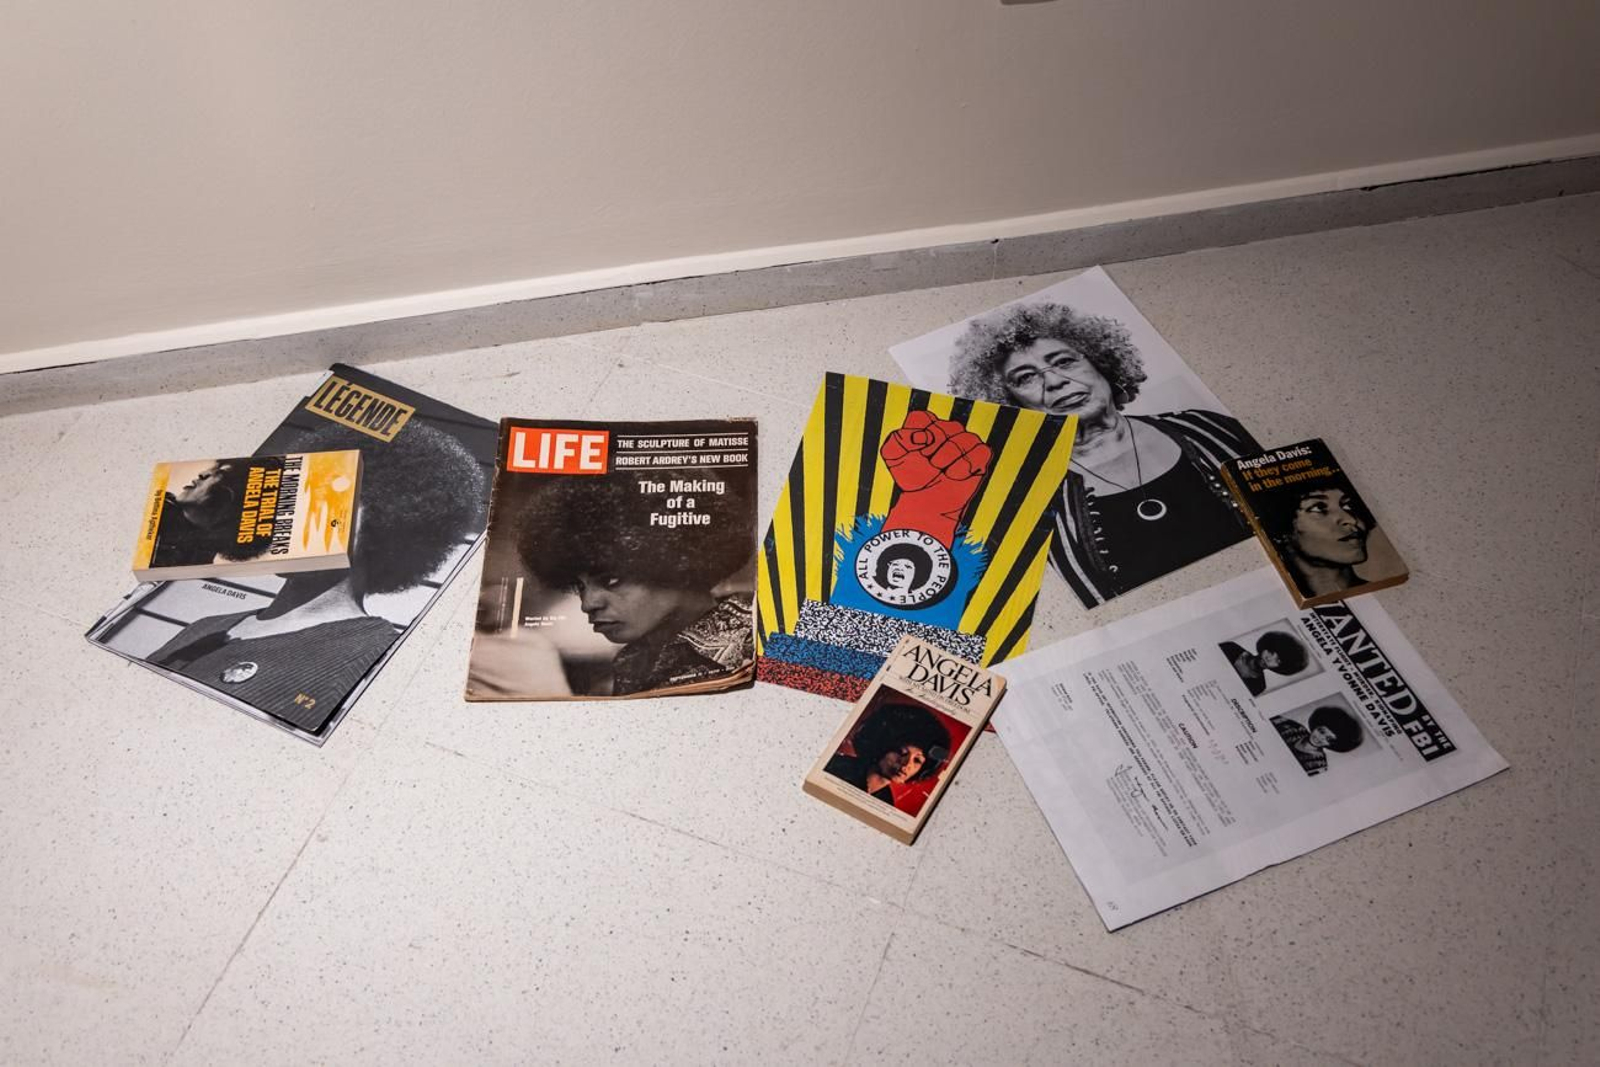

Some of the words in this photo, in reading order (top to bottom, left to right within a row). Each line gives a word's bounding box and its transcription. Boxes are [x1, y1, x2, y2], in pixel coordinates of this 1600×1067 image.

[313, 380, 408, 436] LÉGENDE
[512, 431, 605, 470] LIFE
[617, 438, 634, 449] THE
[637, 438, 690, 449] SCULPTURE
[693, 438, 706, 447] OF
[708, 436, 749, 447] MATISSE
[285, 456, 303, 472] THE
[615, 455, 651, 466] ROBERT
[652, 454, 697, 465] ARDREY'S
[699, 454, 721, 464] NEW
[723, 453, 749, 463] BOOK
[1236, 453, 1277, 471] Angela
[1276, 446, 1313, 461] Davis:
[1254, 465, 1280, 478] they
[1281, 459, 1313, 471] come
[243, 467, 265, 511] ANGELA
[263, 468, 282, 489] THE
[638, 480, 666, 494] The
[669, 479, 726, 495] Making
[1248, 481, 1262, 493] in
[1263, 477, 1283, 489] the
[258, 490, 278, 522] TRIAL
[277, 473, 300, 517] MORNING
[666, 495, 683, 509] of
[686, 498, 695, 509] a
[237, 511, 258, 544] DAVIS
[255, 523, 273, 539] OF
[650, 511, 711, 528] Fugitive
[271, 518, 294, 555] BREAKS
[864, 530, 910, 553] POWER
[917, 532, 934, 546] TO
[858, 558, 869, 580] ALL
[933, 546, 950, 569] THE
[202, 584, 227, 595] ANGELA
[900, 574, 947, 604] PEOPLE
[1309, 612, 1336, 647] INTERSTATE
[903, 644, 992, 698] ANGELA
[1301, 617, 1333, 656] ANGELA
[1332, 657, 1369, 701] YVONNE
[1365, 702, 1396, 737] DAVIS
[907, 663, 976, 706] DAVIS
[1178, 723, 1198, 749] CAUTION
[1403, 719, 1440, 756] FBI
[1421, 714, 1435, 728] BY
[1434, 730, 1452, 749] THE
